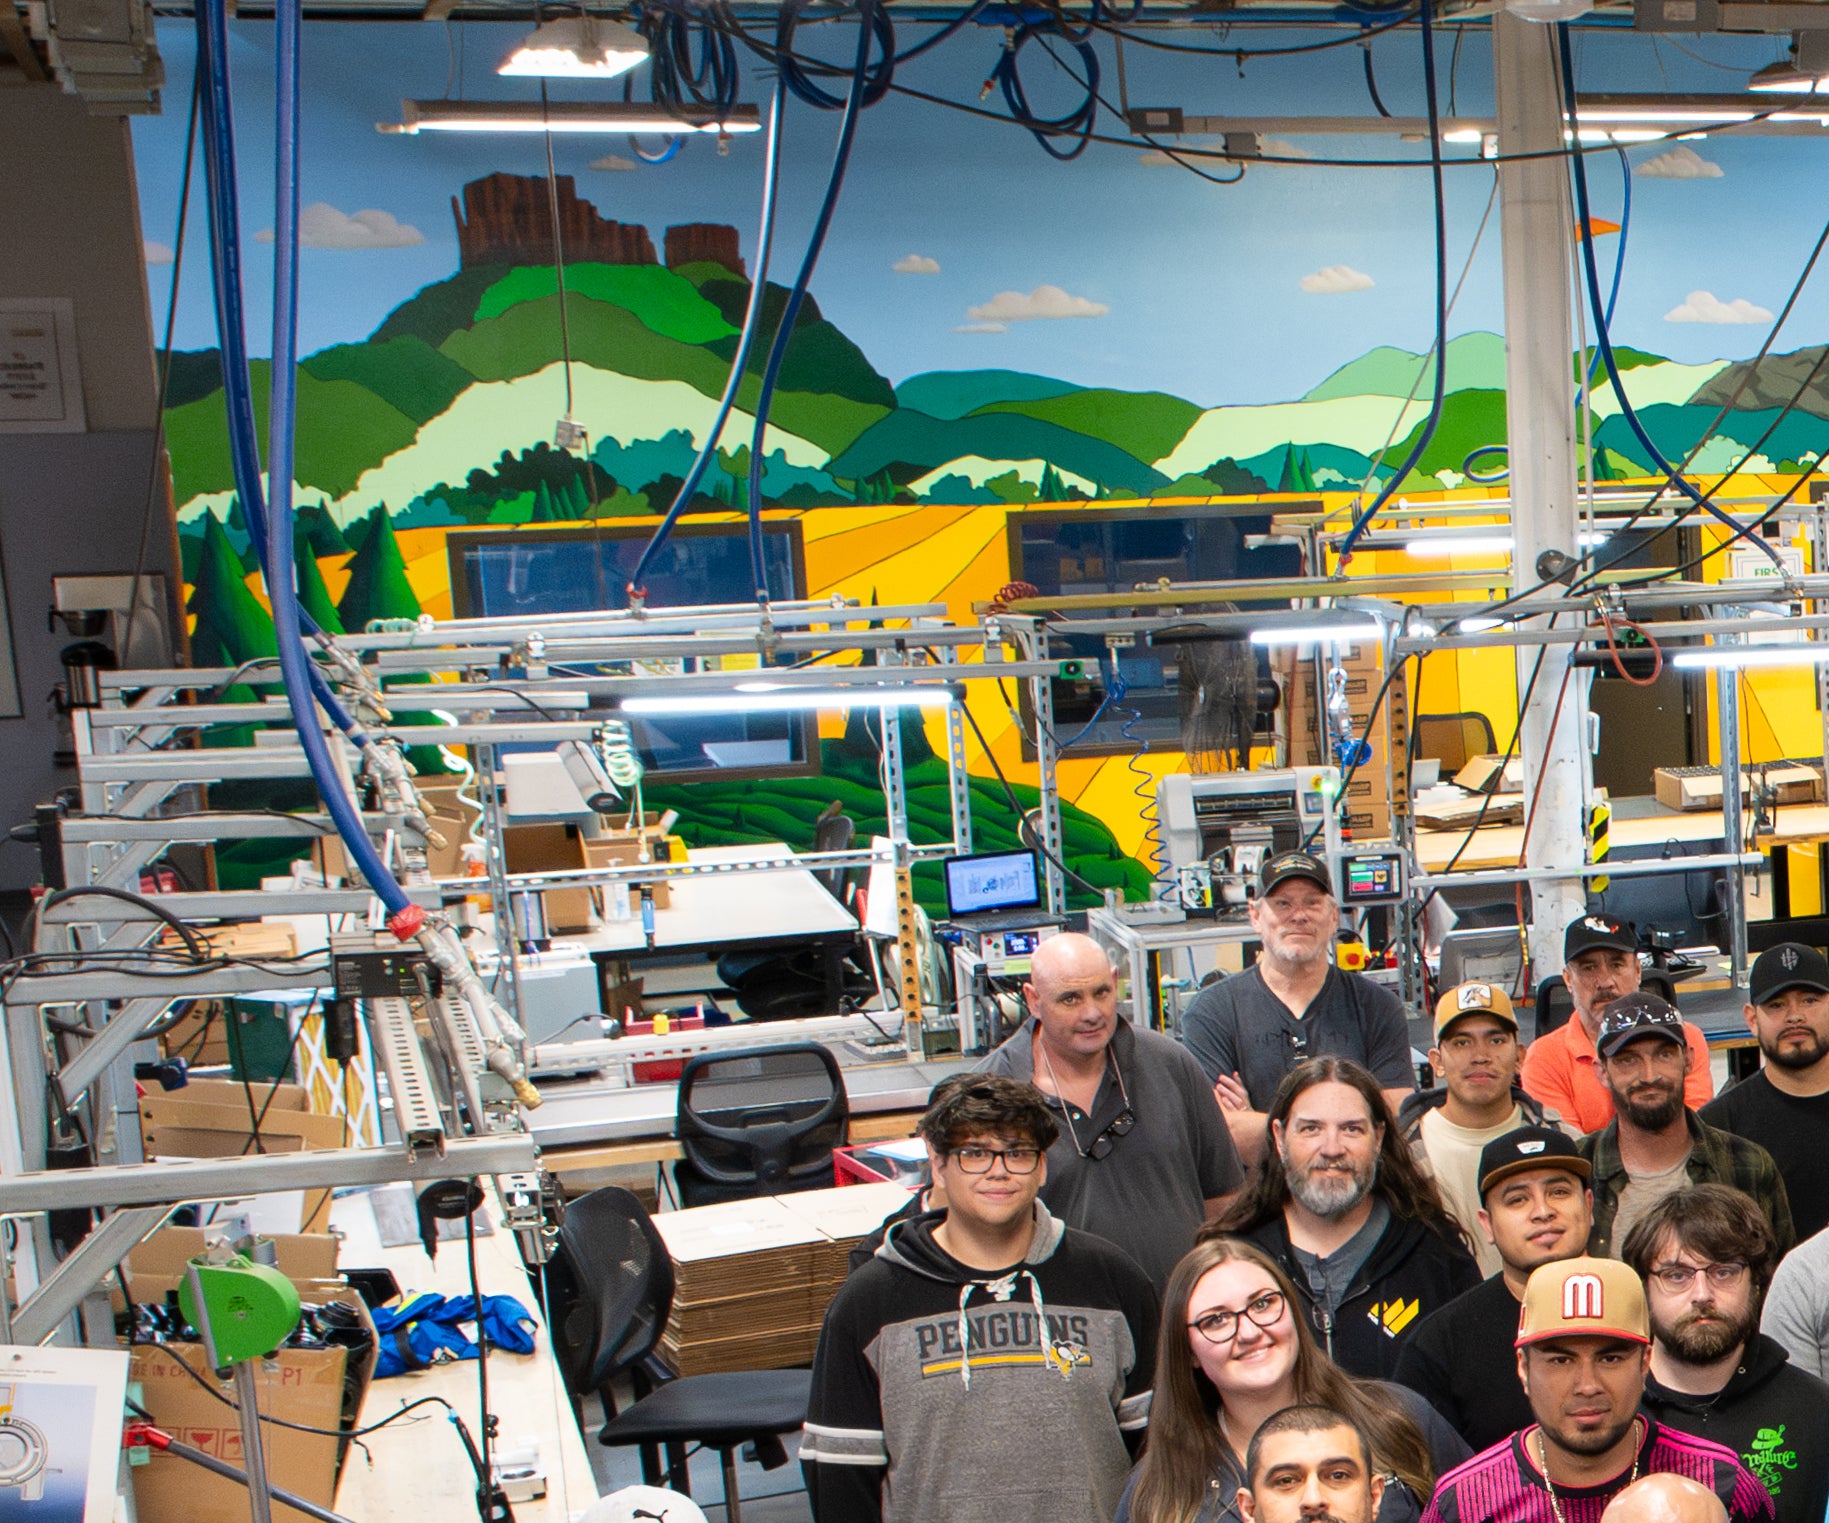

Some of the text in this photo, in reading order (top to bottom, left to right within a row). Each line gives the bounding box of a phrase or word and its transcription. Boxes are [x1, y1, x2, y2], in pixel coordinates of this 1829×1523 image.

[915, 1312, 1088, 1359] PENGUINS
[152, 1363, 165, 1377] IN
[170, 1363, 206, 1377] CHA
